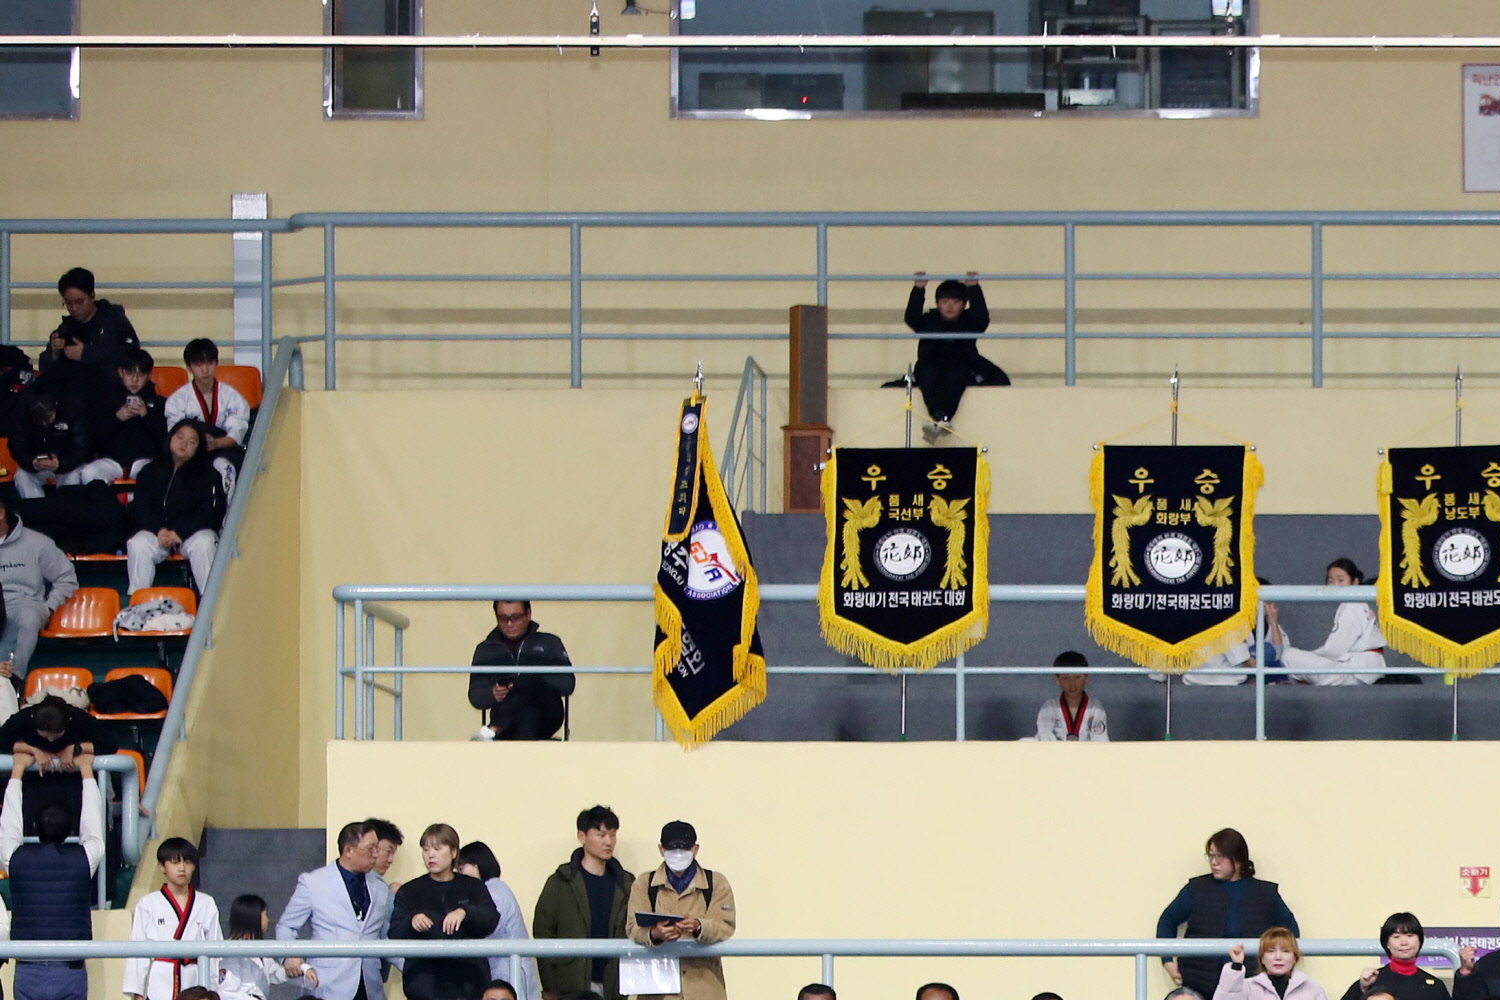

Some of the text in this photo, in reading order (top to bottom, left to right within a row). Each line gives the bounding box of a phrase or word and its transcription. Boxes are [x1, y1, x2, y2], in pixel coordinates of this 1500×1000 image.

[888, 507, 924, 522] 국선부
[1155, 512, 1192, 526] 화랑부
[1444, 507, 1481, 520] 낭도부
